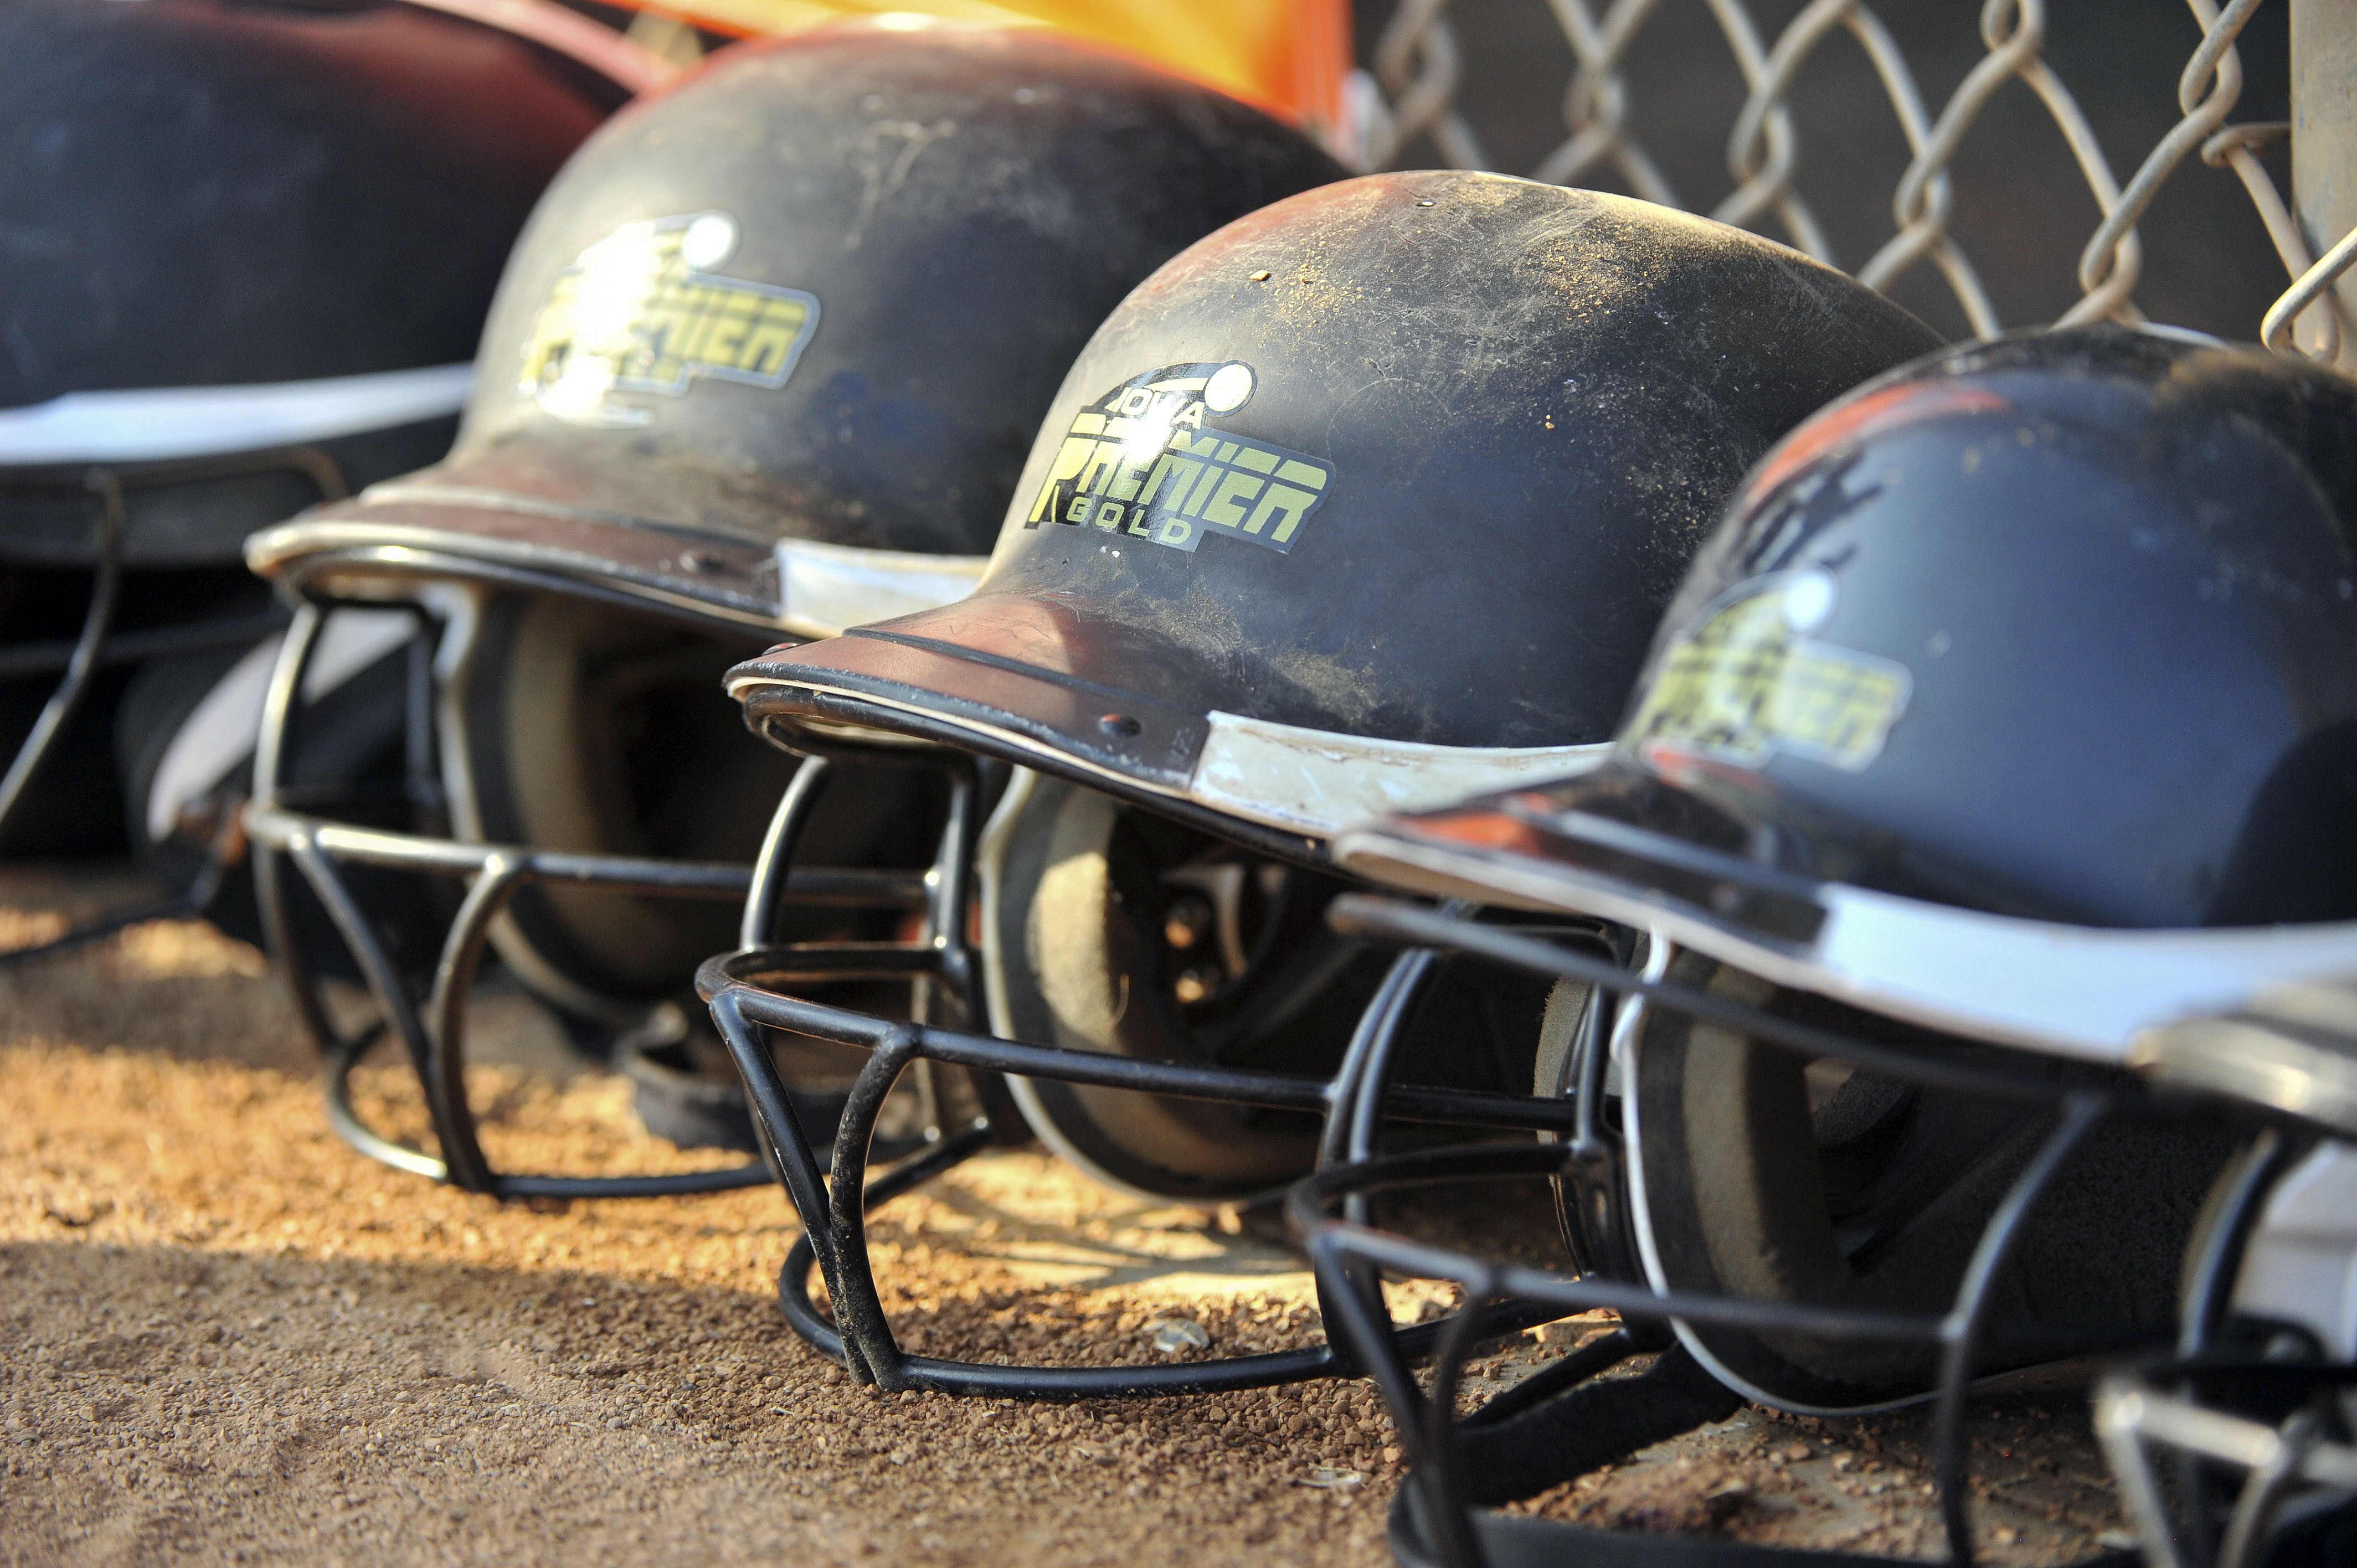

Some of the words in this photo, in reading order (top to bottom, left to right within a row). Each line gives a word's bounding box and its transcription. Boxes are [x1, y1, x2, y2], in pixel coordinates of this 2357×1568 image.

[519, 275, 807, 382] PMIER
[1111, 387, 1206, 429] IOWA
[1028, 412, 1328, 543] PREMIER
[1067, 496, 1192, 544] GOLD
